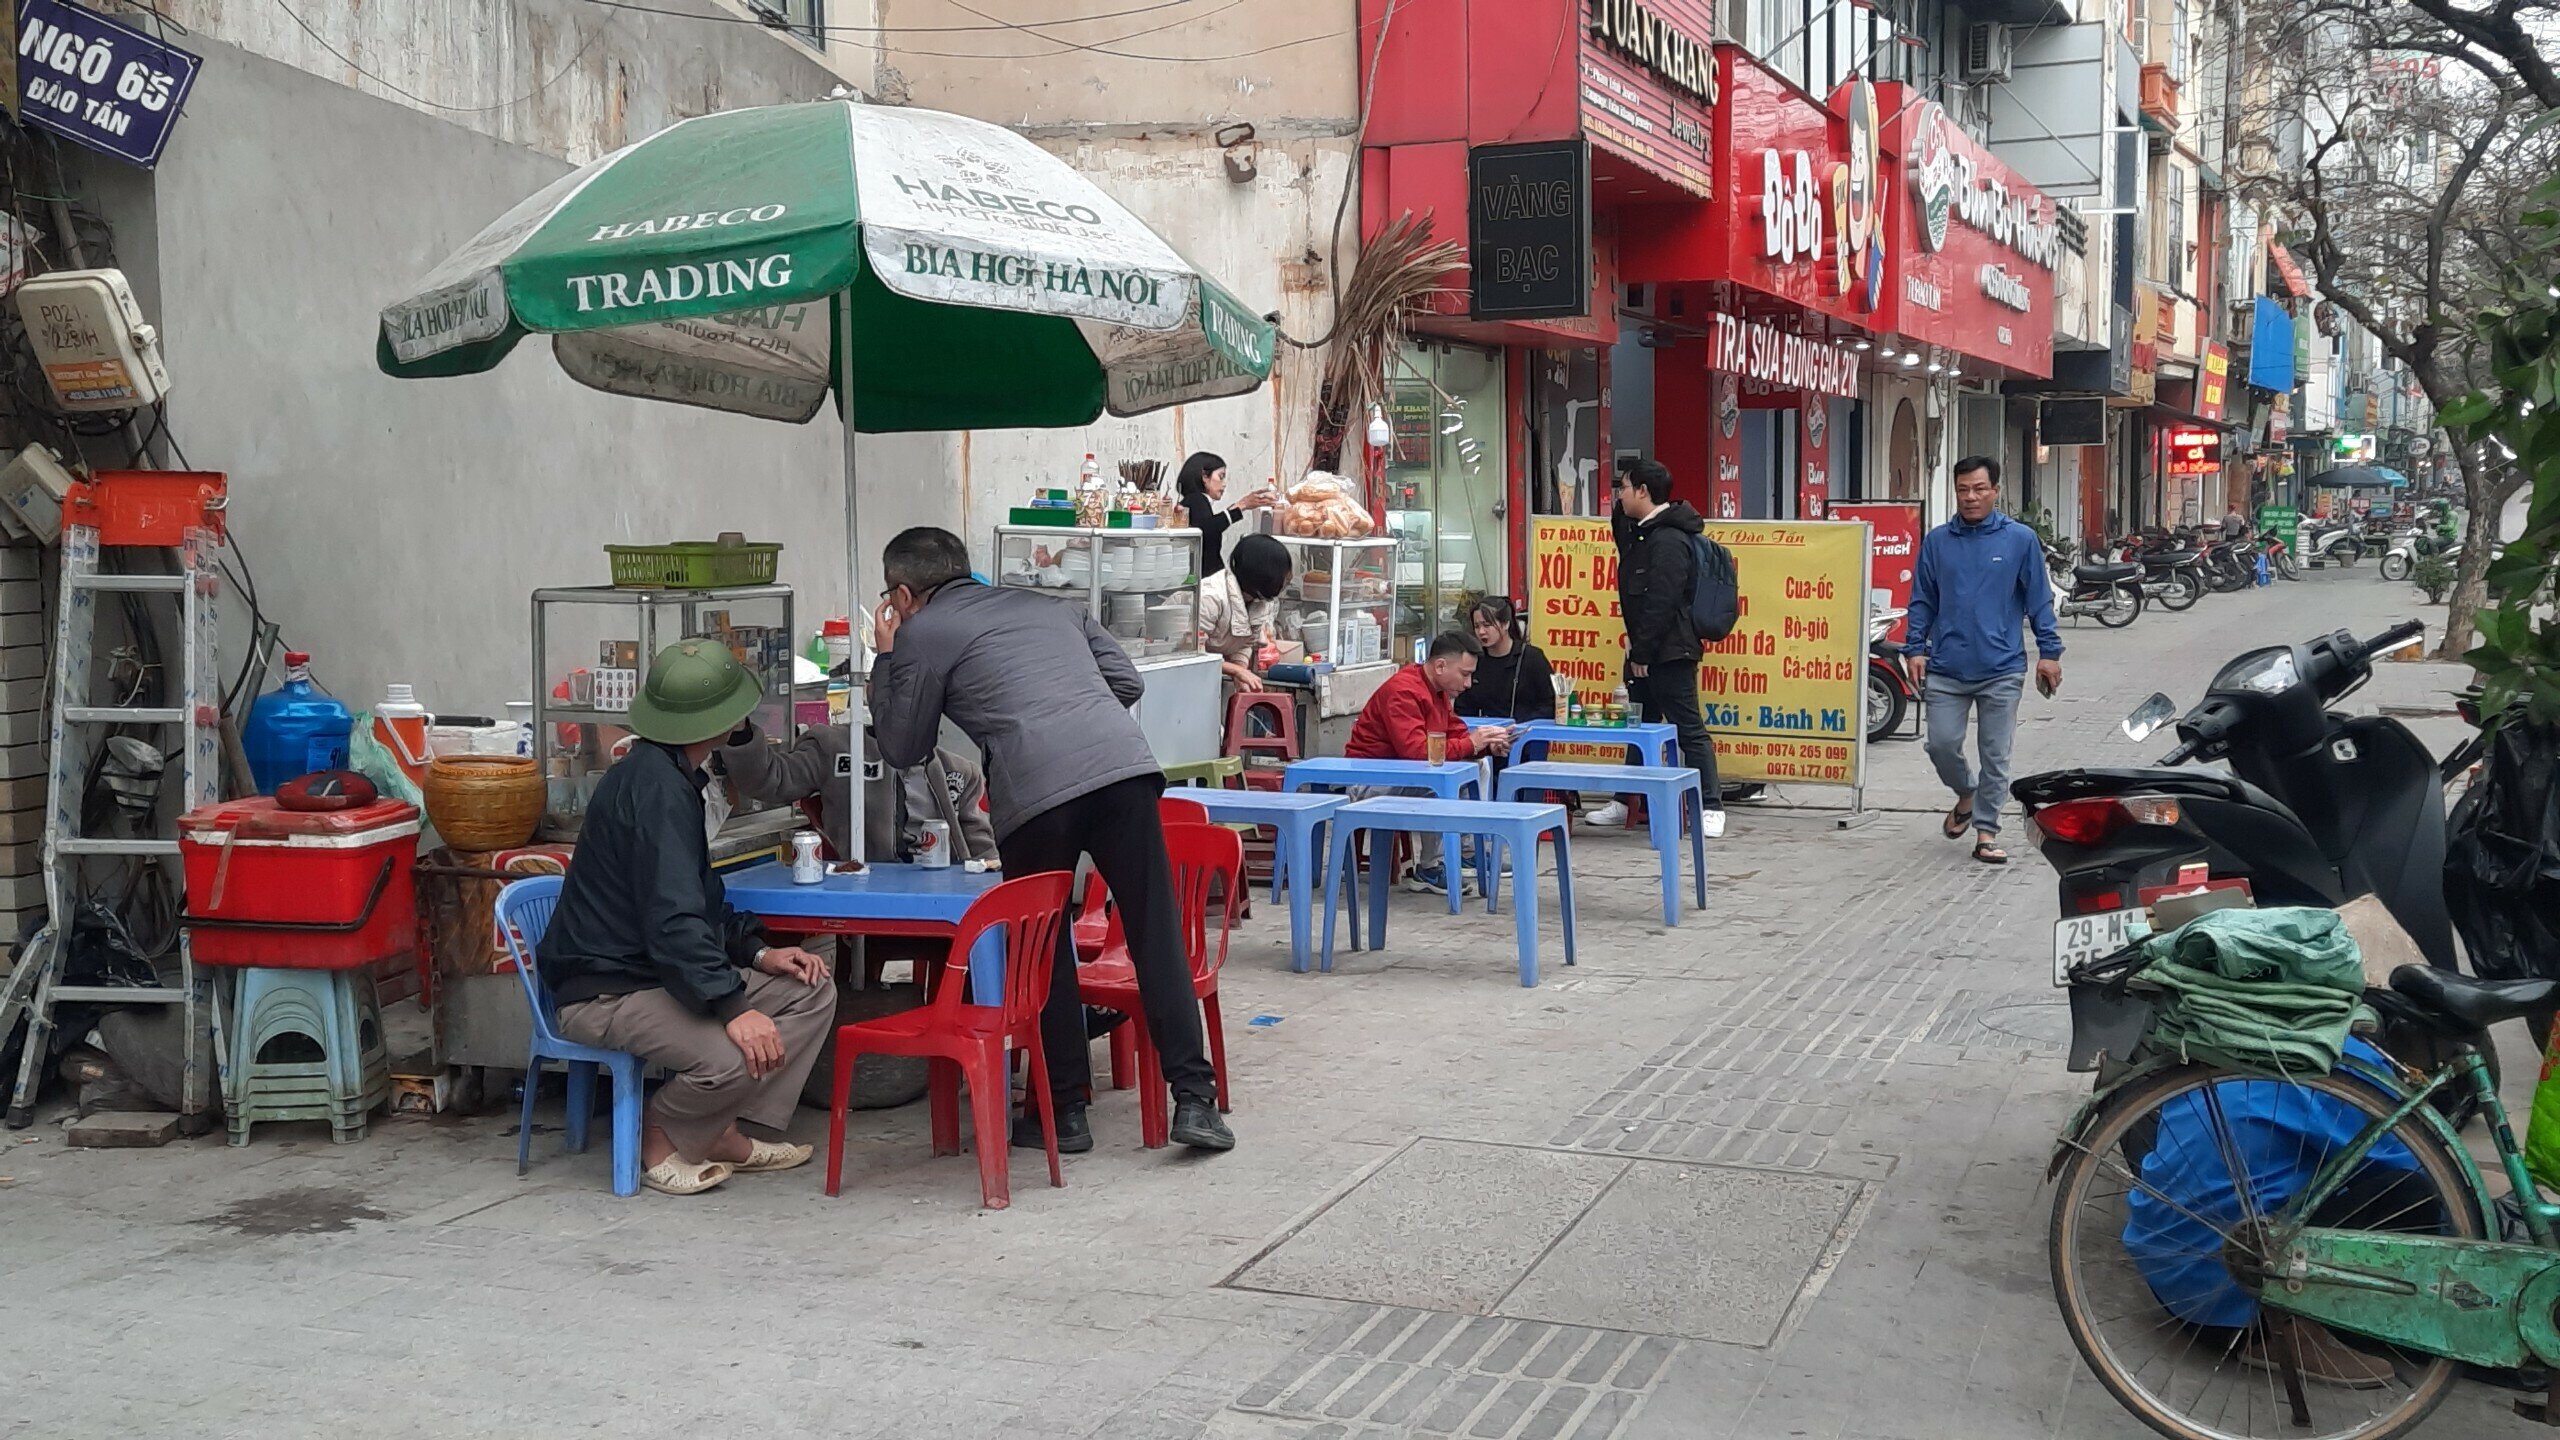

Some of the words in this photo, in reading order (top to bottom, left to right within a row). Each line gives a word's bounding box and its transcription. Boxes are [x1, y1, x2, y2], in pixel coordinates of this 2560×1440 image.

[19, 17, 114, 84] NGÕ
[116, 61, 175, 112] 65
[1660, 20, 1720, 105] KHANG
[82, 99, 132, 136] TẤN
[892, 174, 1101, 225] HABECO
[1482, 174, 1571, 222] VÀNG
[588, 204, 787, 243] HABECO
[566, 253, 794, 312] TRADING
[904, 243, 966, 279] BIA
[1045, 257, 1094, 297] HÀ
[1100, 267, 1160, 313] NỘI
[1496, 245, 1559, 293] BẠC
[1716, 306, 1747, 375] TRÀ
[1720, 454, 1739, 481] Bún
[1808, 461, 1825, 485] Bún
[1721, 491, 1736, 518] Bò
[1810, 493, 1823, 517] Bò
[1540, 528, 1556, 541] 67
[1590, 525, 1615, 543] TẤN
[1771, 529, 1806, 544] Tấn
[1539, 546, 1573, 590] XÔI
[1785, 573, 1834, 600] Cua-ốc
[1546, 594, 1602, 617] SỮA
[1547, 629, 1600, 652] THỊT
[1753, 629, 1776, 656] đa
[1702, 665, 1728, 696] Mỳ
[1733, 667, 1768, 695] tôm
[1783, 655, 1831, 680] Cá-chả
[1836, 658, 1853, 681] cá
[1704, 703, 1740, 726] Xôi
[1759, 705, 1814, 731] Bánh
[1820, 708, 1847, 732] Mì
[1766, 743, 1796, 757] 0974
[1799, 745, 1821, 759] 265
[1825, 747, 1848, 760] 099
[1767, 763, 1796, 776] 0976
[1800, 764, 1822, 778] 177
[1825, 765, 1847, 780] 087
